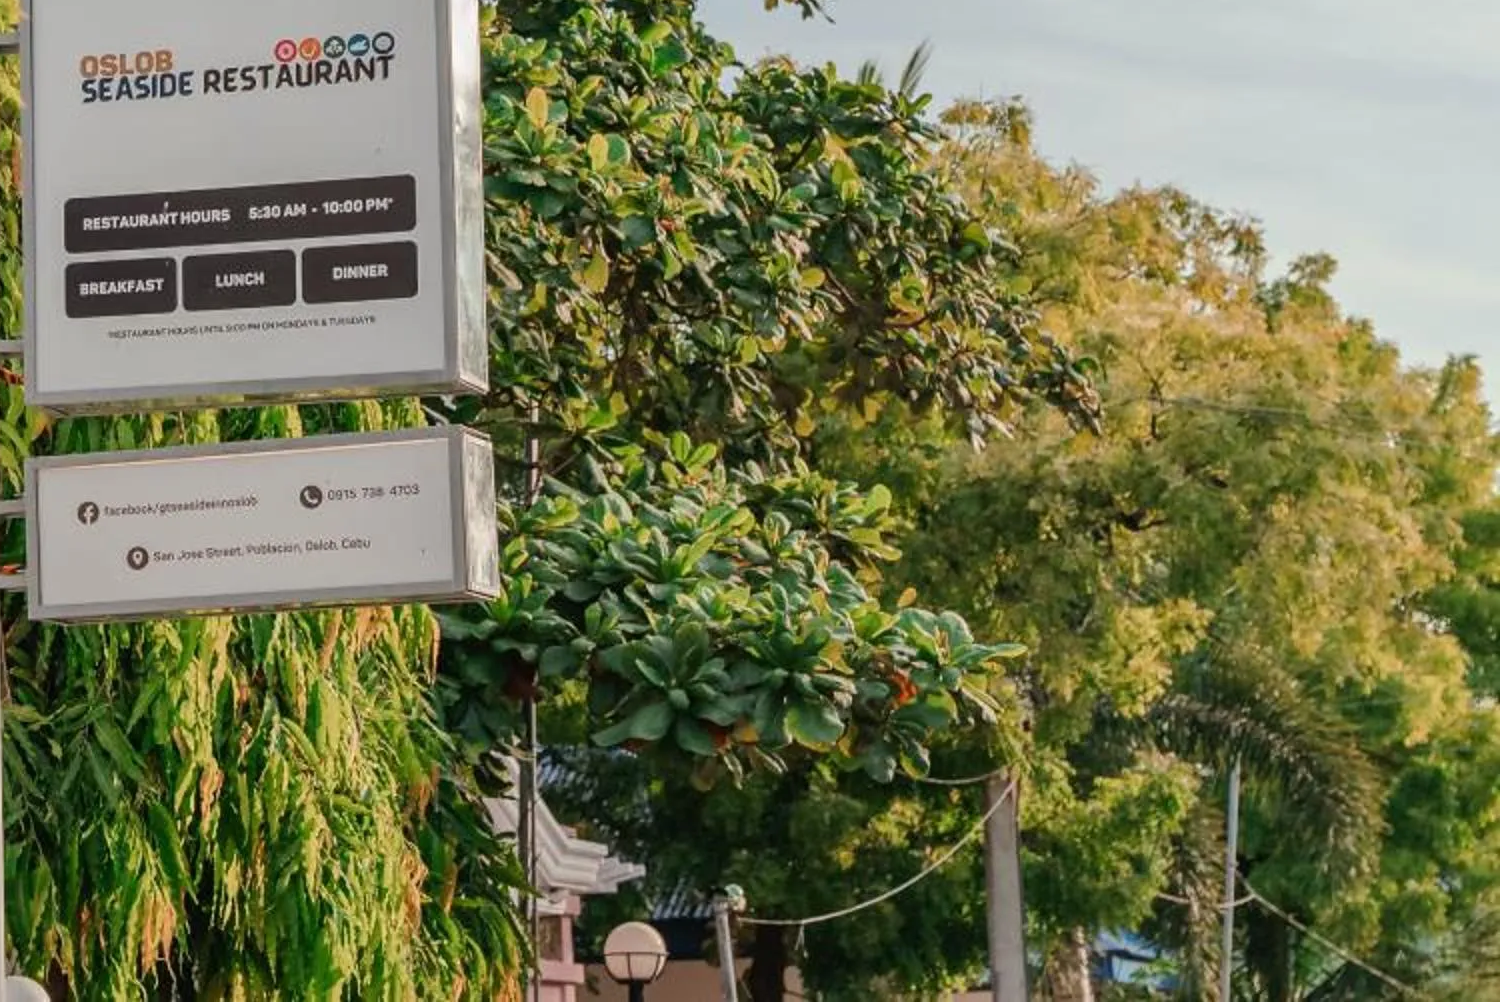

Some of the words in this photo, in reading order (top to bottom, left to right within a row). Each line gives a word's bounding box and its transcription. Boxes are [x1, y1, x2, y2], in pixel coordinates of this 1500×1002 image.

[79, 50, 173, 79] OSLOB
[81, 71, 194, 103] SEASIDE
[203, 55, 395, 95] RESTAURANT
[82, 211, 179, 231] RESTAURANT
[180, 208, 231, 225] HOURS
[284, 203, 307, 217] AM
[322, 200, 363, 215] 10:00
[79, 278, 164, 296] BREAKFAST
[215, 271, 265, 288] LUNCH
[332, 263, 389, 281] DINNER
[152, 550, 175, 563] San
